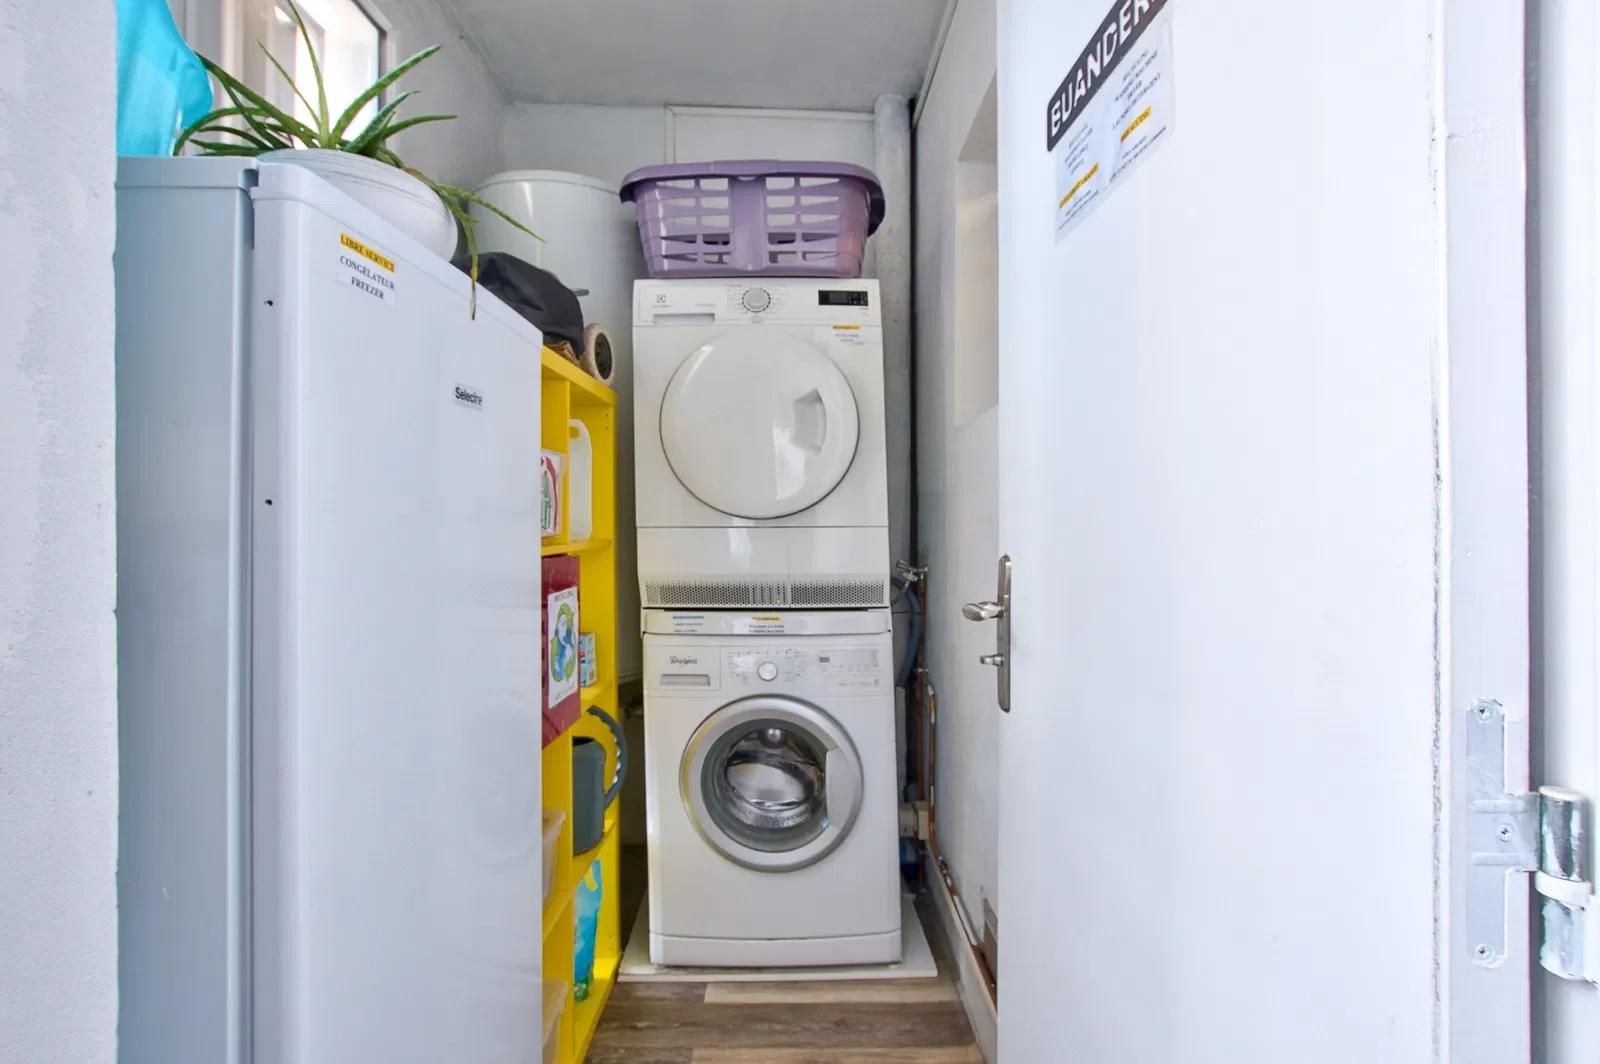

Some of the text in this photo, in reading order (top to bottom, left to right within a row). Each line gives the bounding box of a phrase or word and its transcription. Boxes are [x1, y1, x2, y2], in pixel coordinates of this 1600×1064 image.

[1051, 0, 1155, 137] BUANDER
[341, 233, 395, 273] LIBRE SERVICE
[340, 255, 395, 290] CONGÉLATEUR
[351, 276, 384, 299] FREEZER
